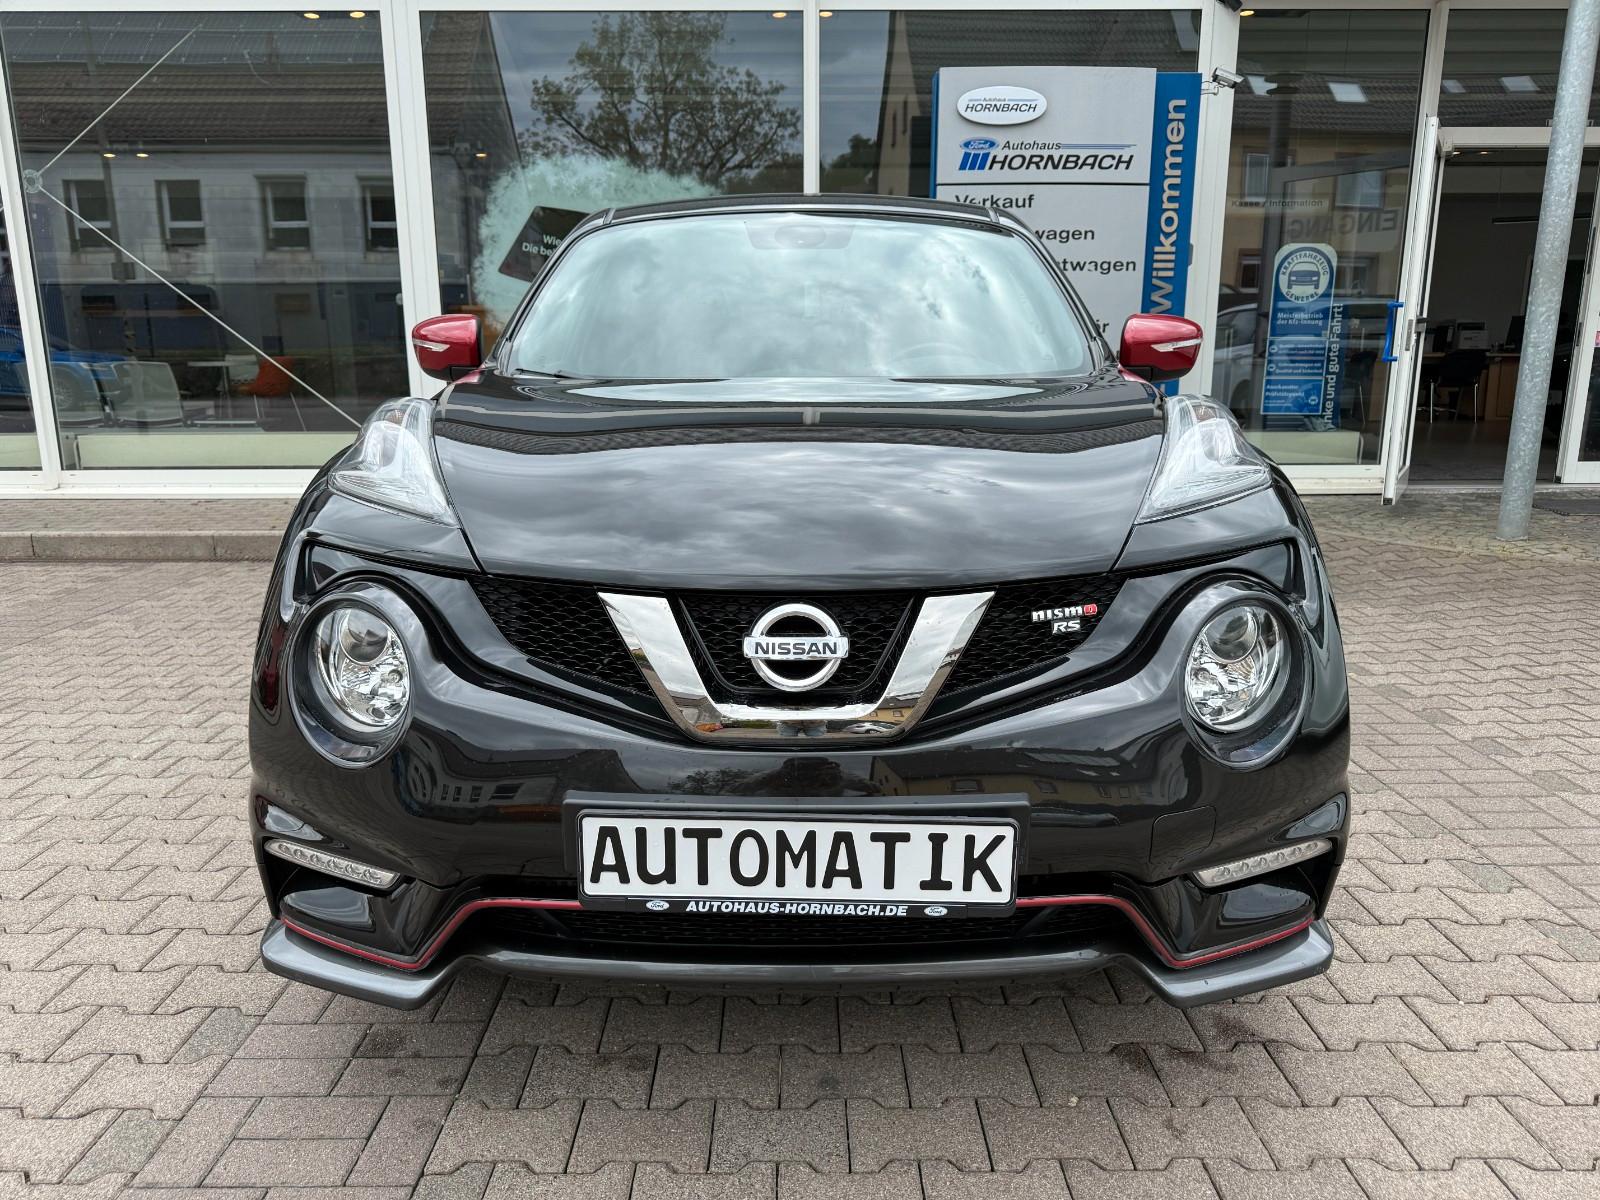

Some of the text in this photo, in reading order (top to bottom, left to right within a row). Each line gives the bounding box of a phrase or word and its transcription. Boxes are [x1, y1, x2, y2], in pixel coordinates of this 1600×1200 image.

[964, 103, 1037, 113] HORNBACH
[1001, 140, 1062, 151] Autohaus
[988, 154, 1134, 170] HORNBACH
[1151, 98, 1187, 316] Willkommen
[1269, 199, 1323, 208] Information
[522, 242, 538, 254] Die
[1328, 344, 1340, 373] gute
[1326, 375, 1337, 399] und
[1032, 603, 1098, 622] nismo
[1052, 620, 1081, 635] RS
[754, 641, 838, 656] NISSAN
[589, 825, 1008, 893] AUTOMATIK
[685, 900, 909, 917] AUTOHAUS-HORNBACH.DE
